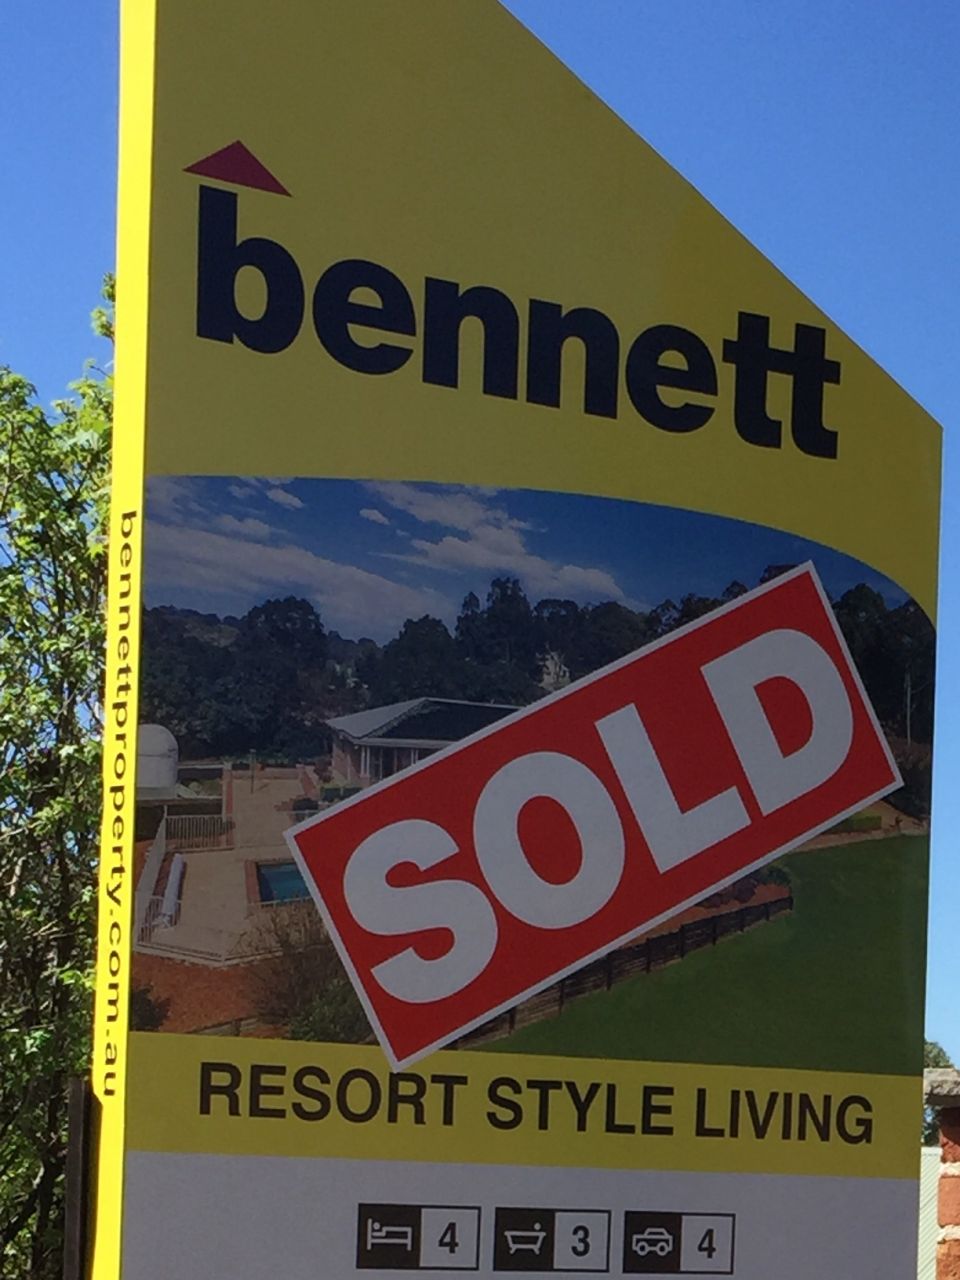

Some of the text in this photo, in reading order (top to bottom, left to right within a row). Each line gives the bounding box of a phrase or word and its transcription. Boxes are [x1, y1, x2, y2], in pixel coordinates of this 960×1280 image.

[197, 184, 841, 459] bennett
[102, 510, 138, 1097] bennettproperty.com.au
[343, 627, 854, 1003] SOLD
[199, 1061, 874, 1145] RESORT STYLE LIVING
[437, 1221, 459, 1254] 4
[570, 1224, 591, 1257] 3
[696, 1227, 717, 1259] 4
